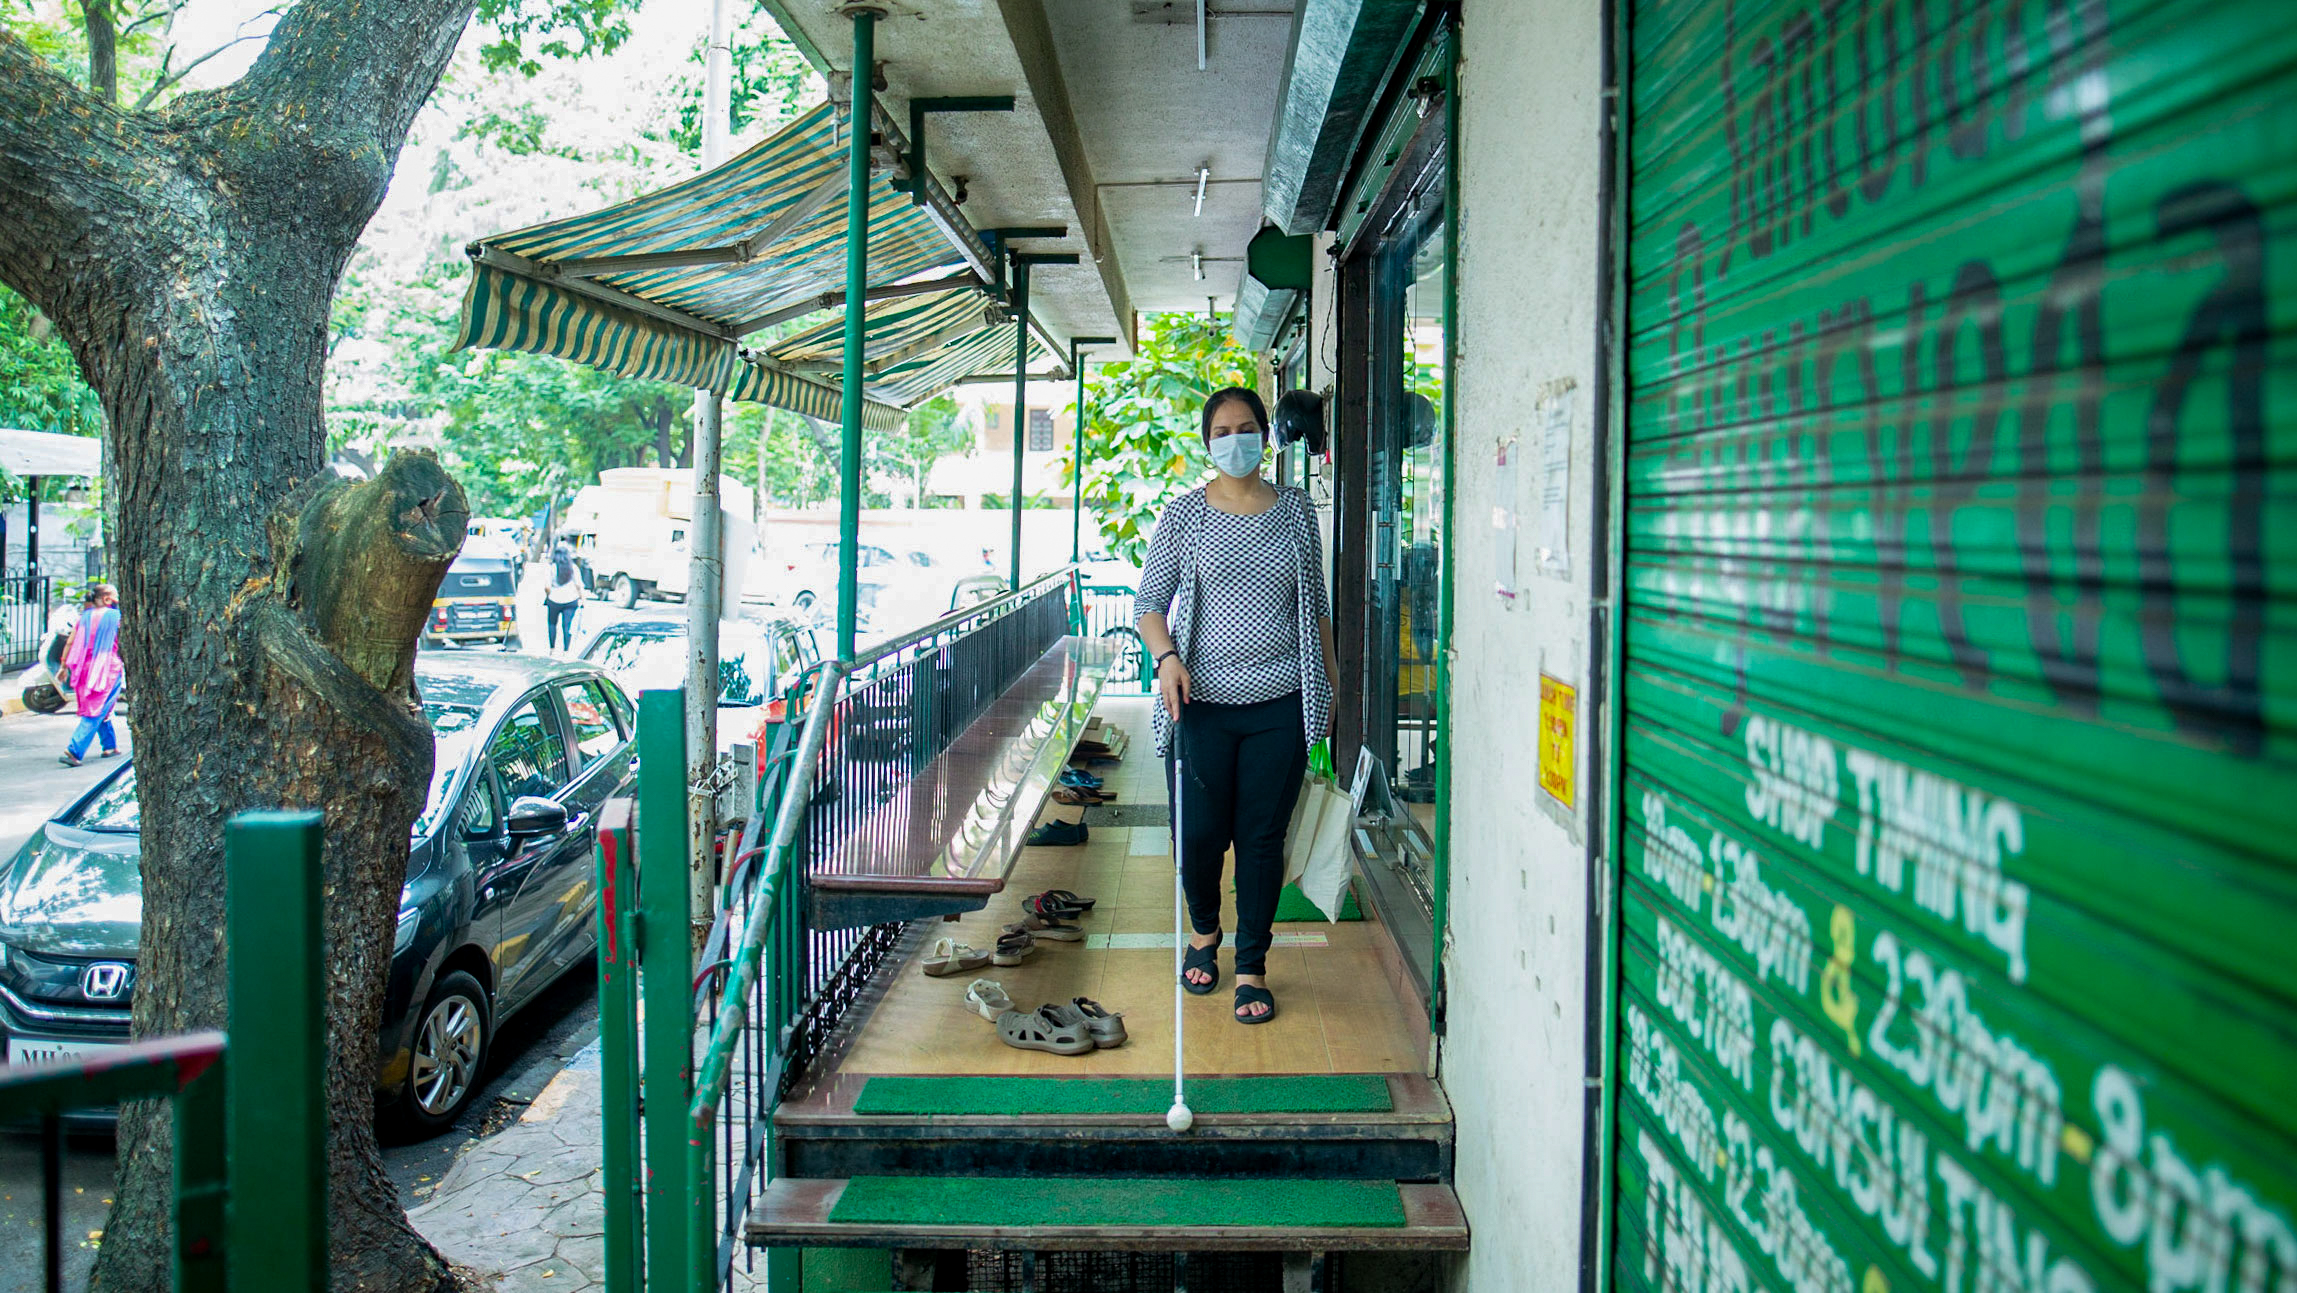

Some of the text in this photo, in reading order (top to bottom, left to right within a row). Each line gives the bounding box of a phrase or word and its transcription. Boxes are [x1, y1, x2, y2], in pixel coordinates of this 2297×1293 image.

[1718, 0, 2075, 282] Santua
[1744, 714, 2028, 985] SHOP TIMING
[1820, 903, 1861, 1058] &
[1655, 914, 2098, 1293] DOCTOR CONSULTIN
